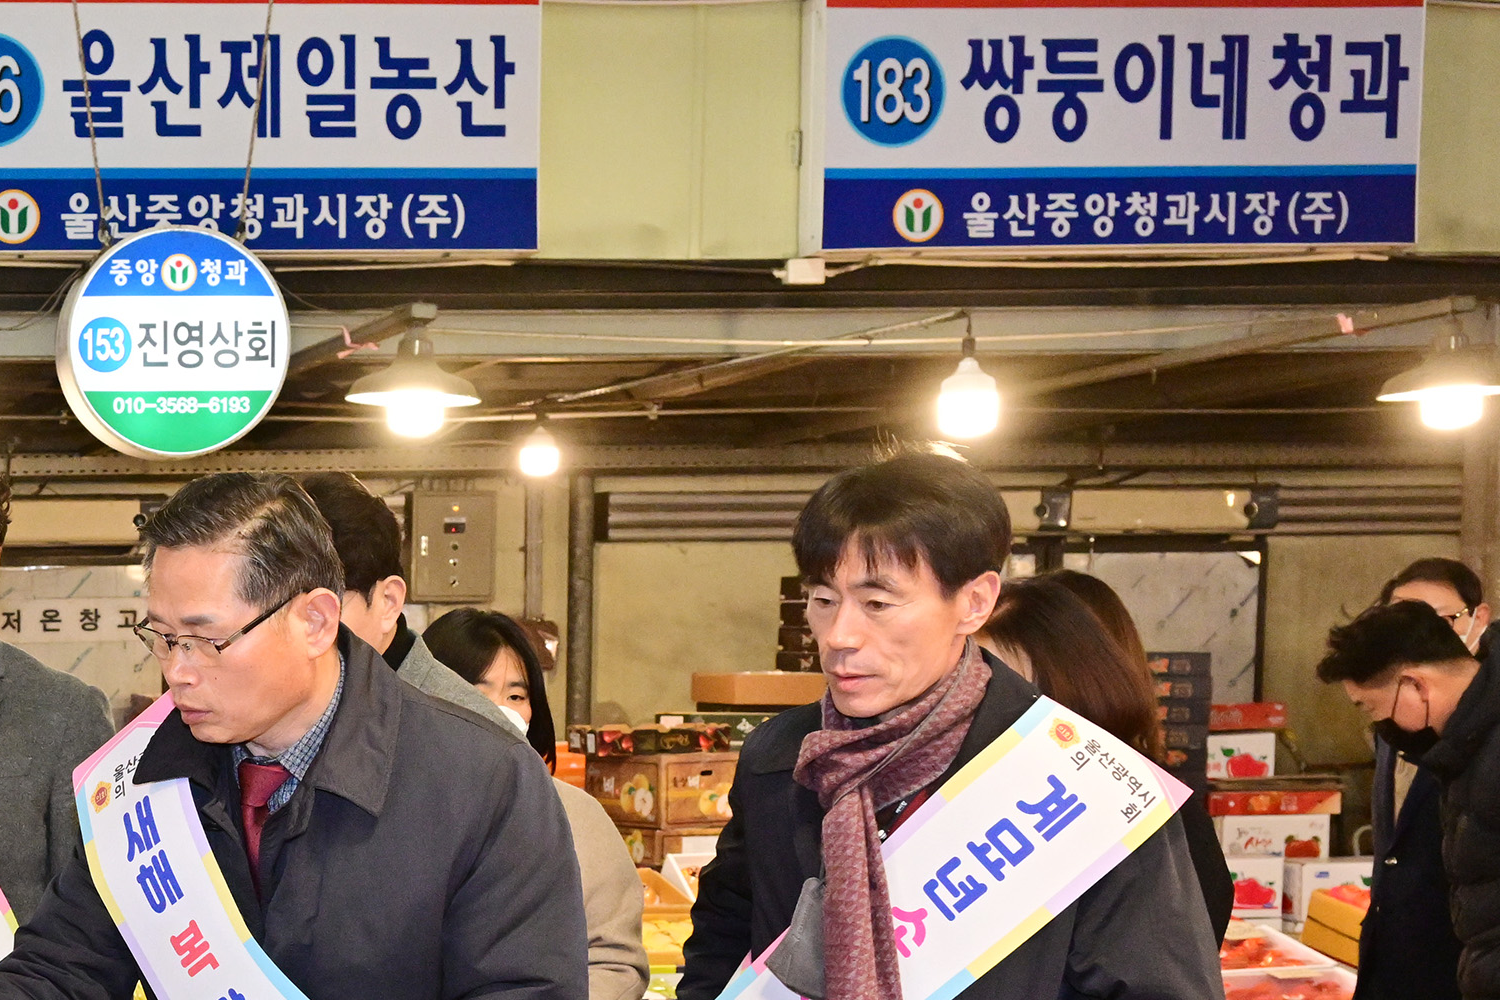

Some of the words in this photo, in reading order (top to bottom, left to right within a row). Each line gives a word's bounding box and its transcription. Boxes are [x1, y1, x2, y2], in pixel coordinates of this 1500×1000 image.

[62, 28, 516, 141] 울산제일농산
[852, 57, 932, 125] 183
[960, 34, 1249, 143] 쌍둥이네
[1269, 33, 1410, 142] 청과
[963, 190, 1349, 238] 울산중앙청과시장(주)
[109, 258, 159, 287] 중앙
[200, 258, 248, 287] 청과
[83, 326, 126, 362] 153
[137, 320, 276, 369] 진영상회
[112, 396, 251, 415] 010-3568-6193
[1084, 739, 1156, 808] 울산광역시
[923, 774, 1087, 921] 계묘년
[123, 795, 184, 913] 새해
[170, 919, 220, 977] 복
